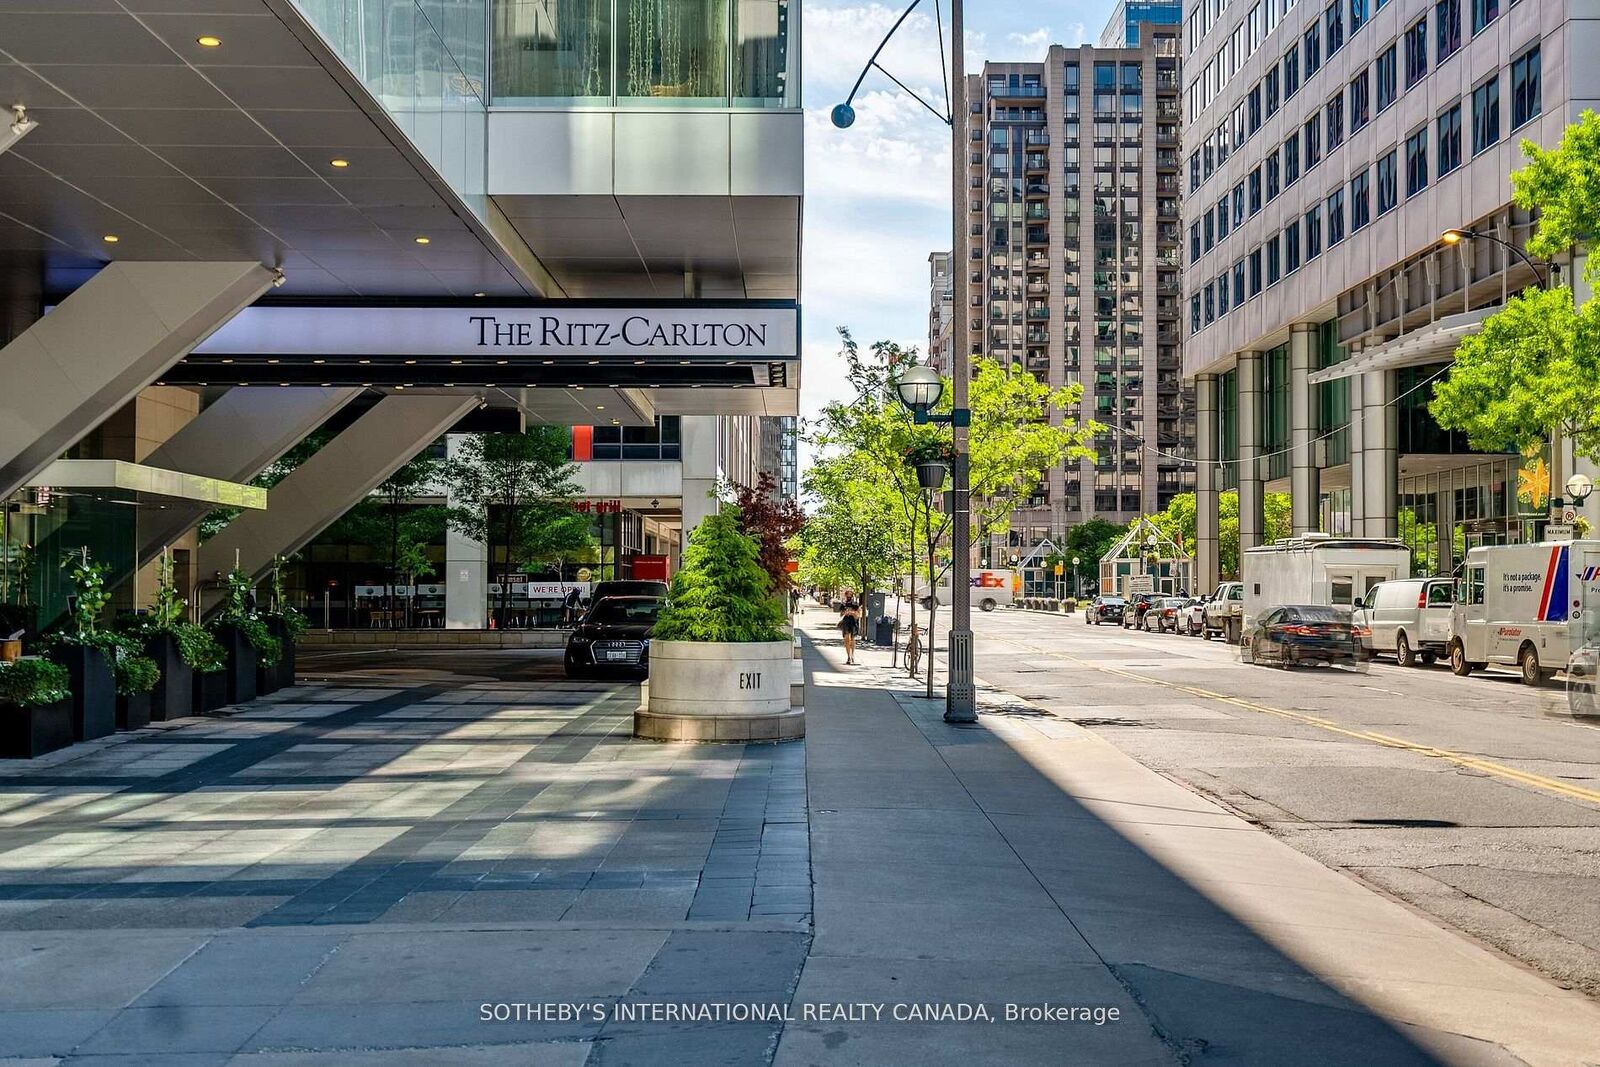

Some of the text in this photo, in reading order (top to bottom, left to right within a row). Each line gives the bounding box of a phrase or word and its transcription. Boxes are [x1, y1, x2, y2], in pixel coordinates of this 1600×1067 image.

[469, 316, 768, 346] THE RITZ-CARLTON
[1510, 573, 1518, 581] not
[740, 673, 761, 689] EXIT
